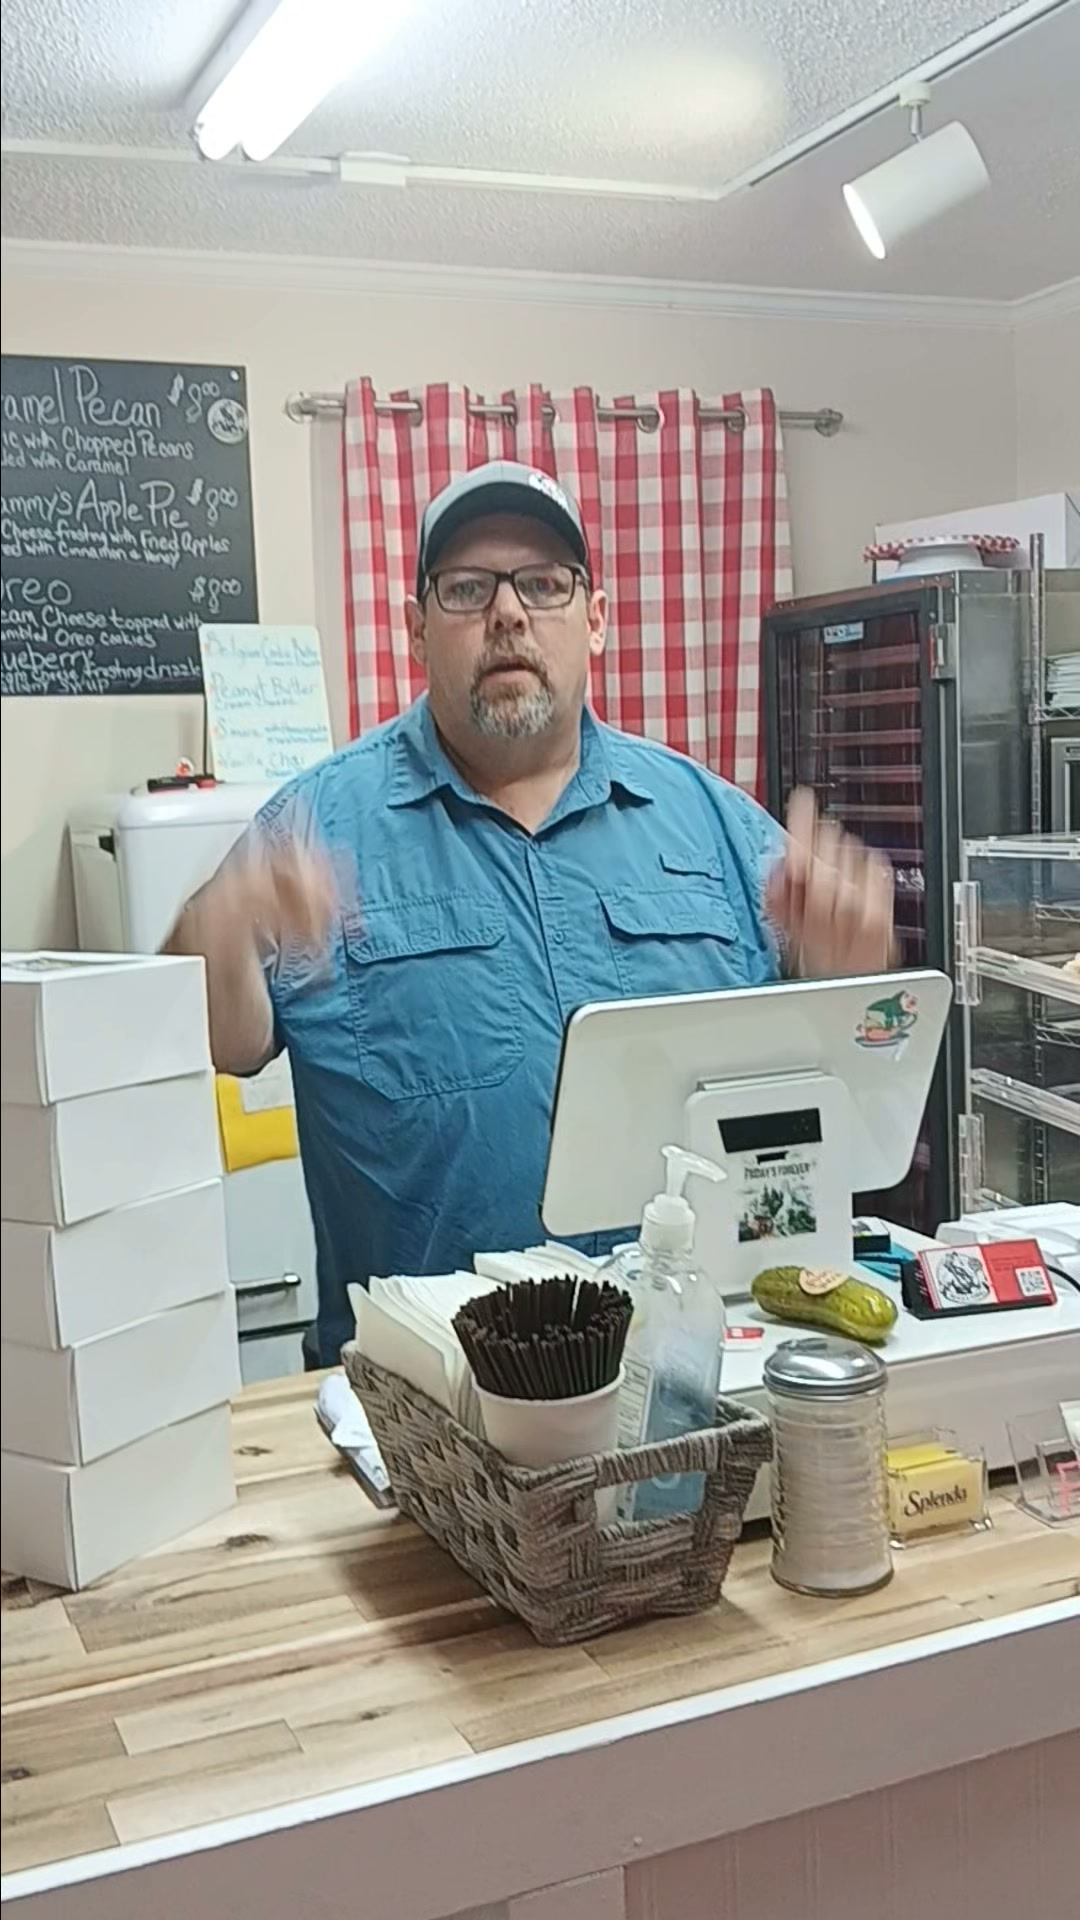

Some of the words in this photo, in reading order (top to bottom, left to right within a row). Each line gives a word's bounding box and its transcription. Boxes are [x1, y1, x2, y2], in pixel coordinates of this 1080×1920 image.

[1, 366, 66, 424] amel
[68, 364, 161, 429] Pecan
[22, 427, 58, 451] with
[62, 425, 137, 460] Chopped
[136, 429, 193, 460] Pecans
[29, 450, 62, 470] with
[65, 451, 130, 476] Caramel
[76, 478, 143, 533] Apple
[140, 480, 189, 528] Pie
[1, 518, 56, 542] Cheese
[141, 528, 178, 553] Fried
[1, 576, 72, 606] reo
[41, 604, 107, 629] Cheese
[109, 607, 172, 634] topped
[55, 627, 95, 647] Oreo
[1, 641, 94, 677] ueberry
[903, 1485, 968, 1518] Splenda
